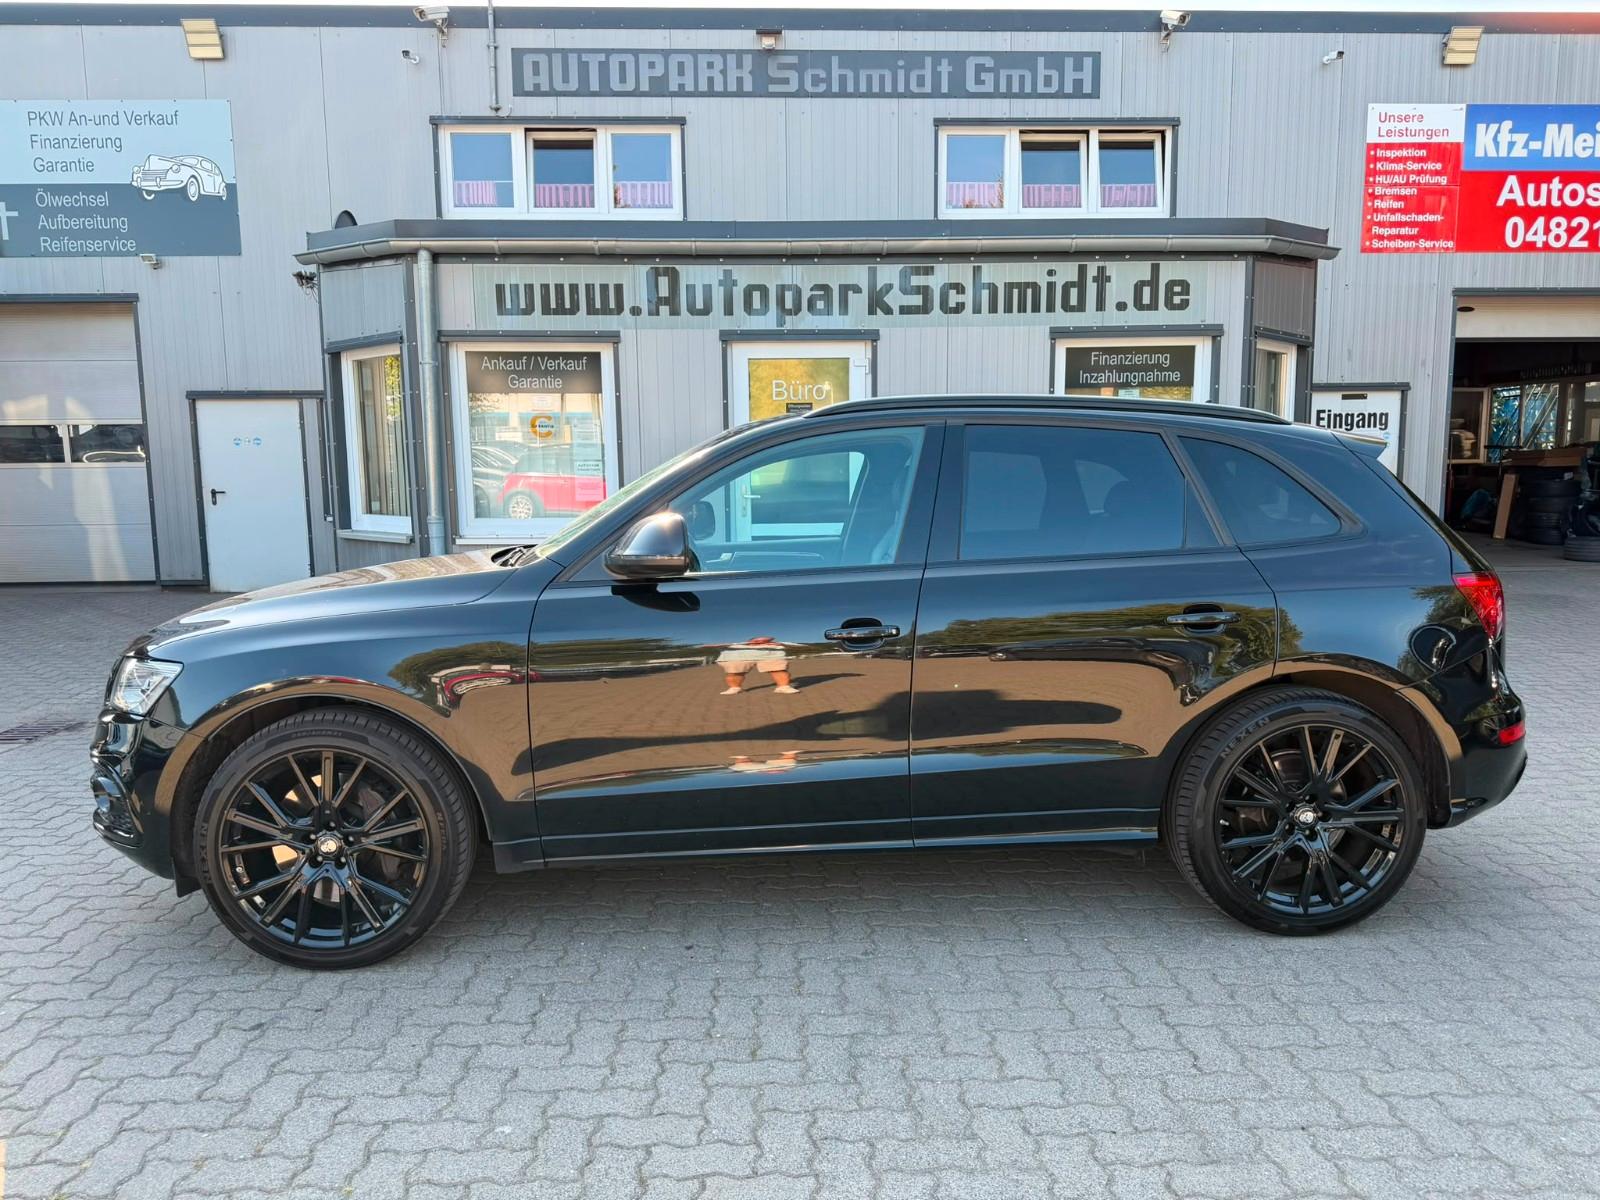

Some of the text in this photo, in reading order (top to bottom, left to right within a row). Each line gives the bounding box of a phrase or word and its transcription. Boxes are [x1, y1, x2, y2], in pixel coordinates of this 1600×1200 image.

[522, 53, 1093, 94] AUTOPARK Schmidt GmbH
[27, 109, 179, 127] PKW An-und Verkauf
[1378, 111, 1424, 123] Unsere
[1377, 125, 1450, 140] Leistungen
[29, 134, 123, 153] Finanzierung
[1376, 148, 1427, 159] Inspektion
[33, 156, 95, 173] Garantie
[1375, 161, 1442, 171] Klima-Service
[1375, 174, 1448, 185] HU/AU Prüfung
[35, 188, 109, 208] Ölwechsel
[1374, 187, 1418, 195] Bremsen
[1495, 174, 1600, 207] Autos
[1373, 199, 1405, 209] Reifen
[38, 214, 128, 233] Aufbereitung
[1372, 212, 1445, 222] Unfallschaden-
[1371, 226, 1420, 236] Reparatur
[40, 236, 136, 252] Reifenservice
[1371, 239, 1454, 248] Scheiben-Service
[495, 262, 1191, 328] www.AutoparkSchmidt.de
[481, 355, 527, 371] Ankauf
[537, 356, 588, 371] Verkauf
[1091, 351, 1170, 368] Finanzierung
[507, 374, 563, 389] Garantie
[1079, 368, 1181, 386] Inzahlungnahme
[772, 379, 827, 401] Büro
[1315, 409, 1389, 431] Eingang
[1219, 716, 1272, 759] NEXEN
